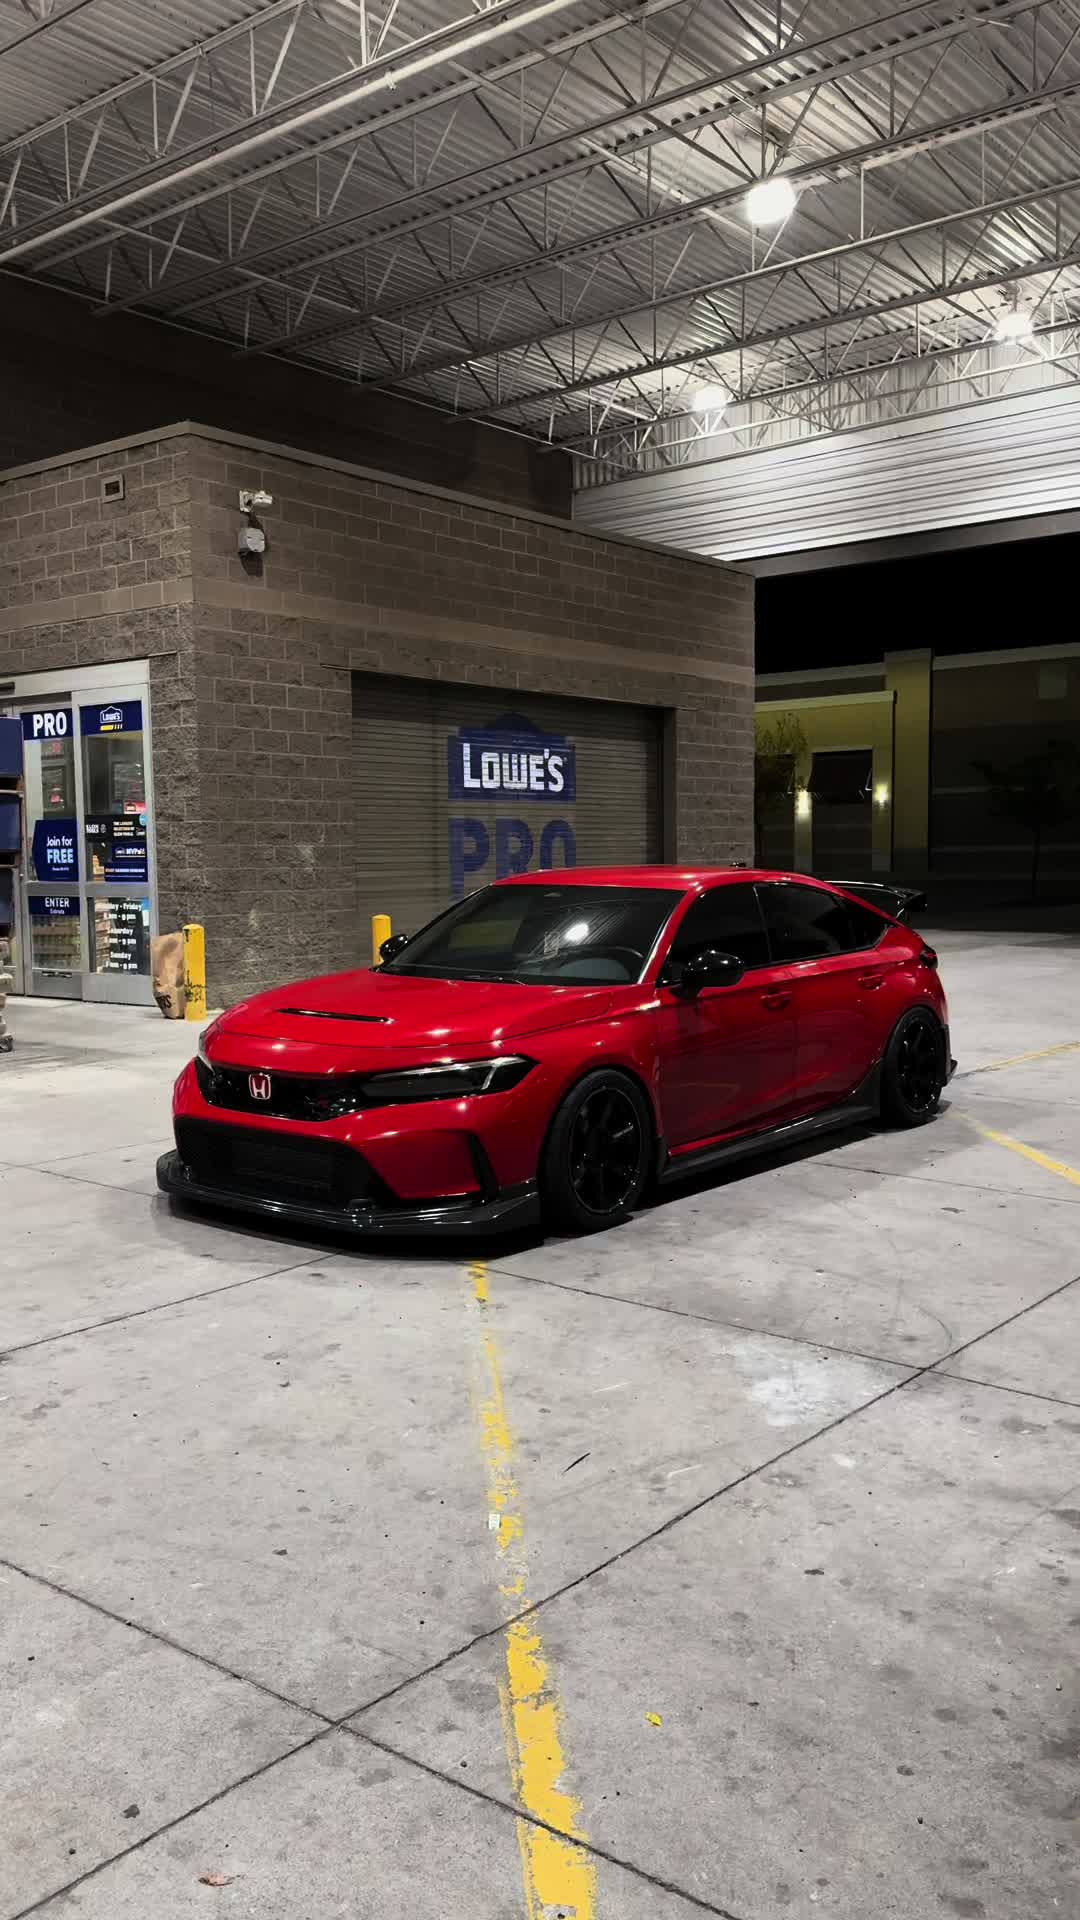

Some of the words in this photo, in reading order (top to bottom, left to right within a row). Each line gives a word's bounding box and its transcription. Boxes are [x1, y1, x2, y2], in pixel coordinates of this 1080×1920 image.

[33, 712, 67, 737] PRO
[463, 743, 565, 792] LOWE'S
[46, 836, 60, 847] Join
[61, 835, 72, 846] for
[47, 848, 73, 863] FREE
[45, 897, 69, 907] ENTER
